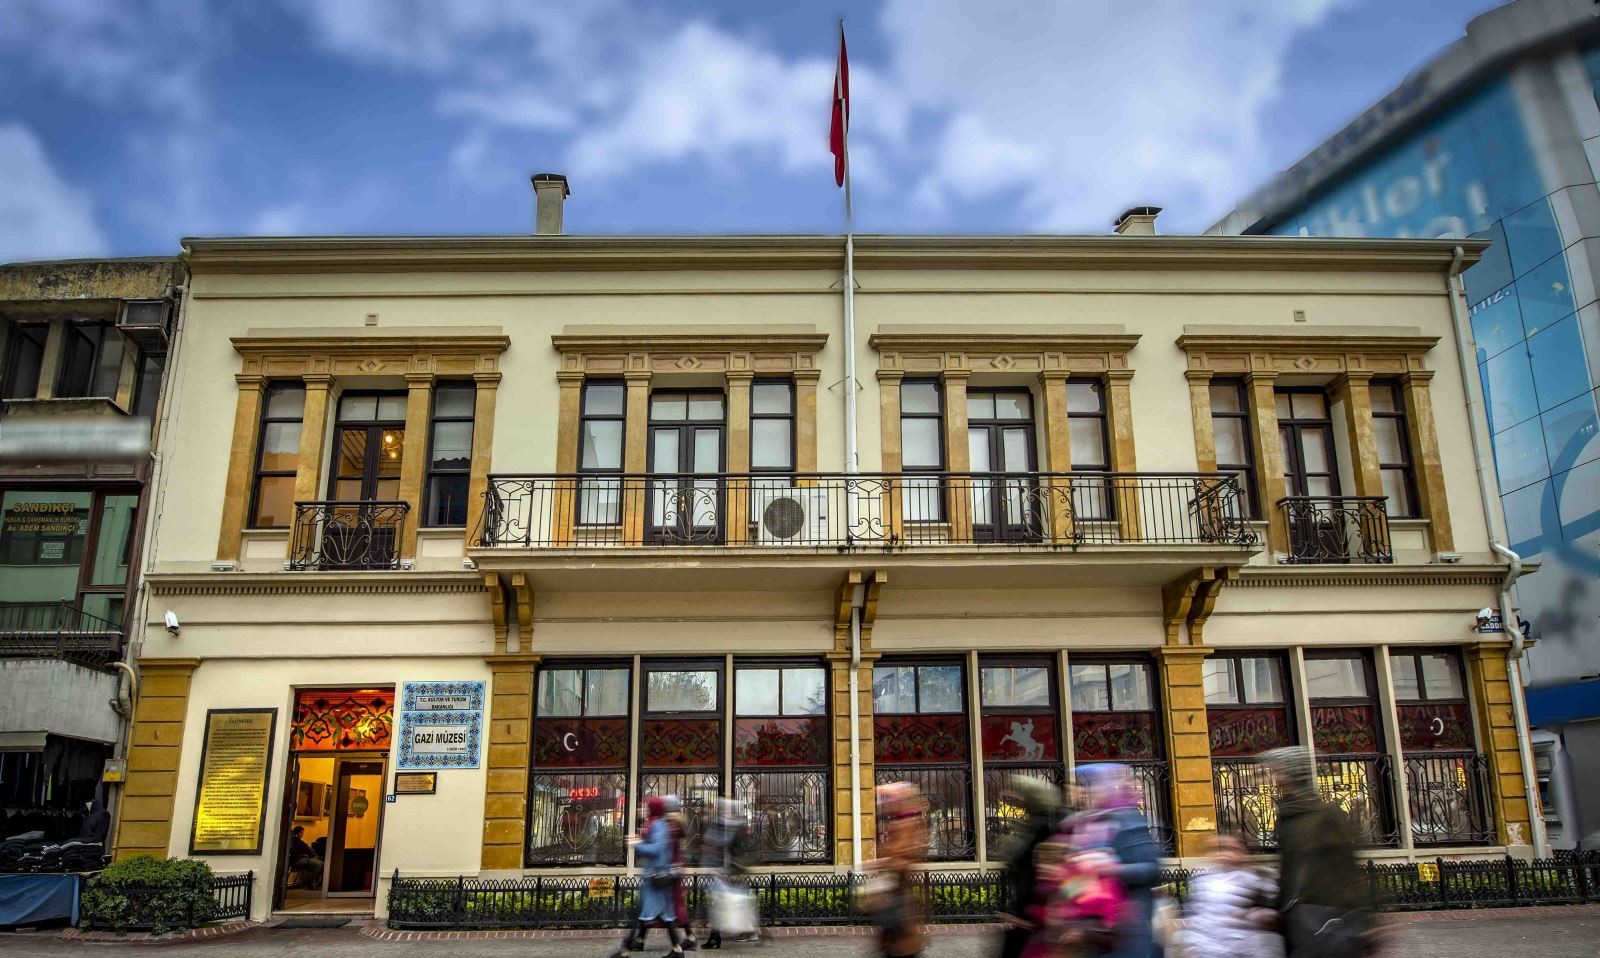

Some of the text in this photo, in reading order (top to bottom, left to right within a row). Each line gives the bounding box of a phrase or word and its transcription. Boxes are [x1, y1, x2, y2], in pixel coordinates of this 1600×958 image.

[14, 502, 75, 514] SANDIKÇI
[40, 524, 76, 534] SANDIKÇI
[414, 730, 466, 744] GAZİ MÜZESİ
